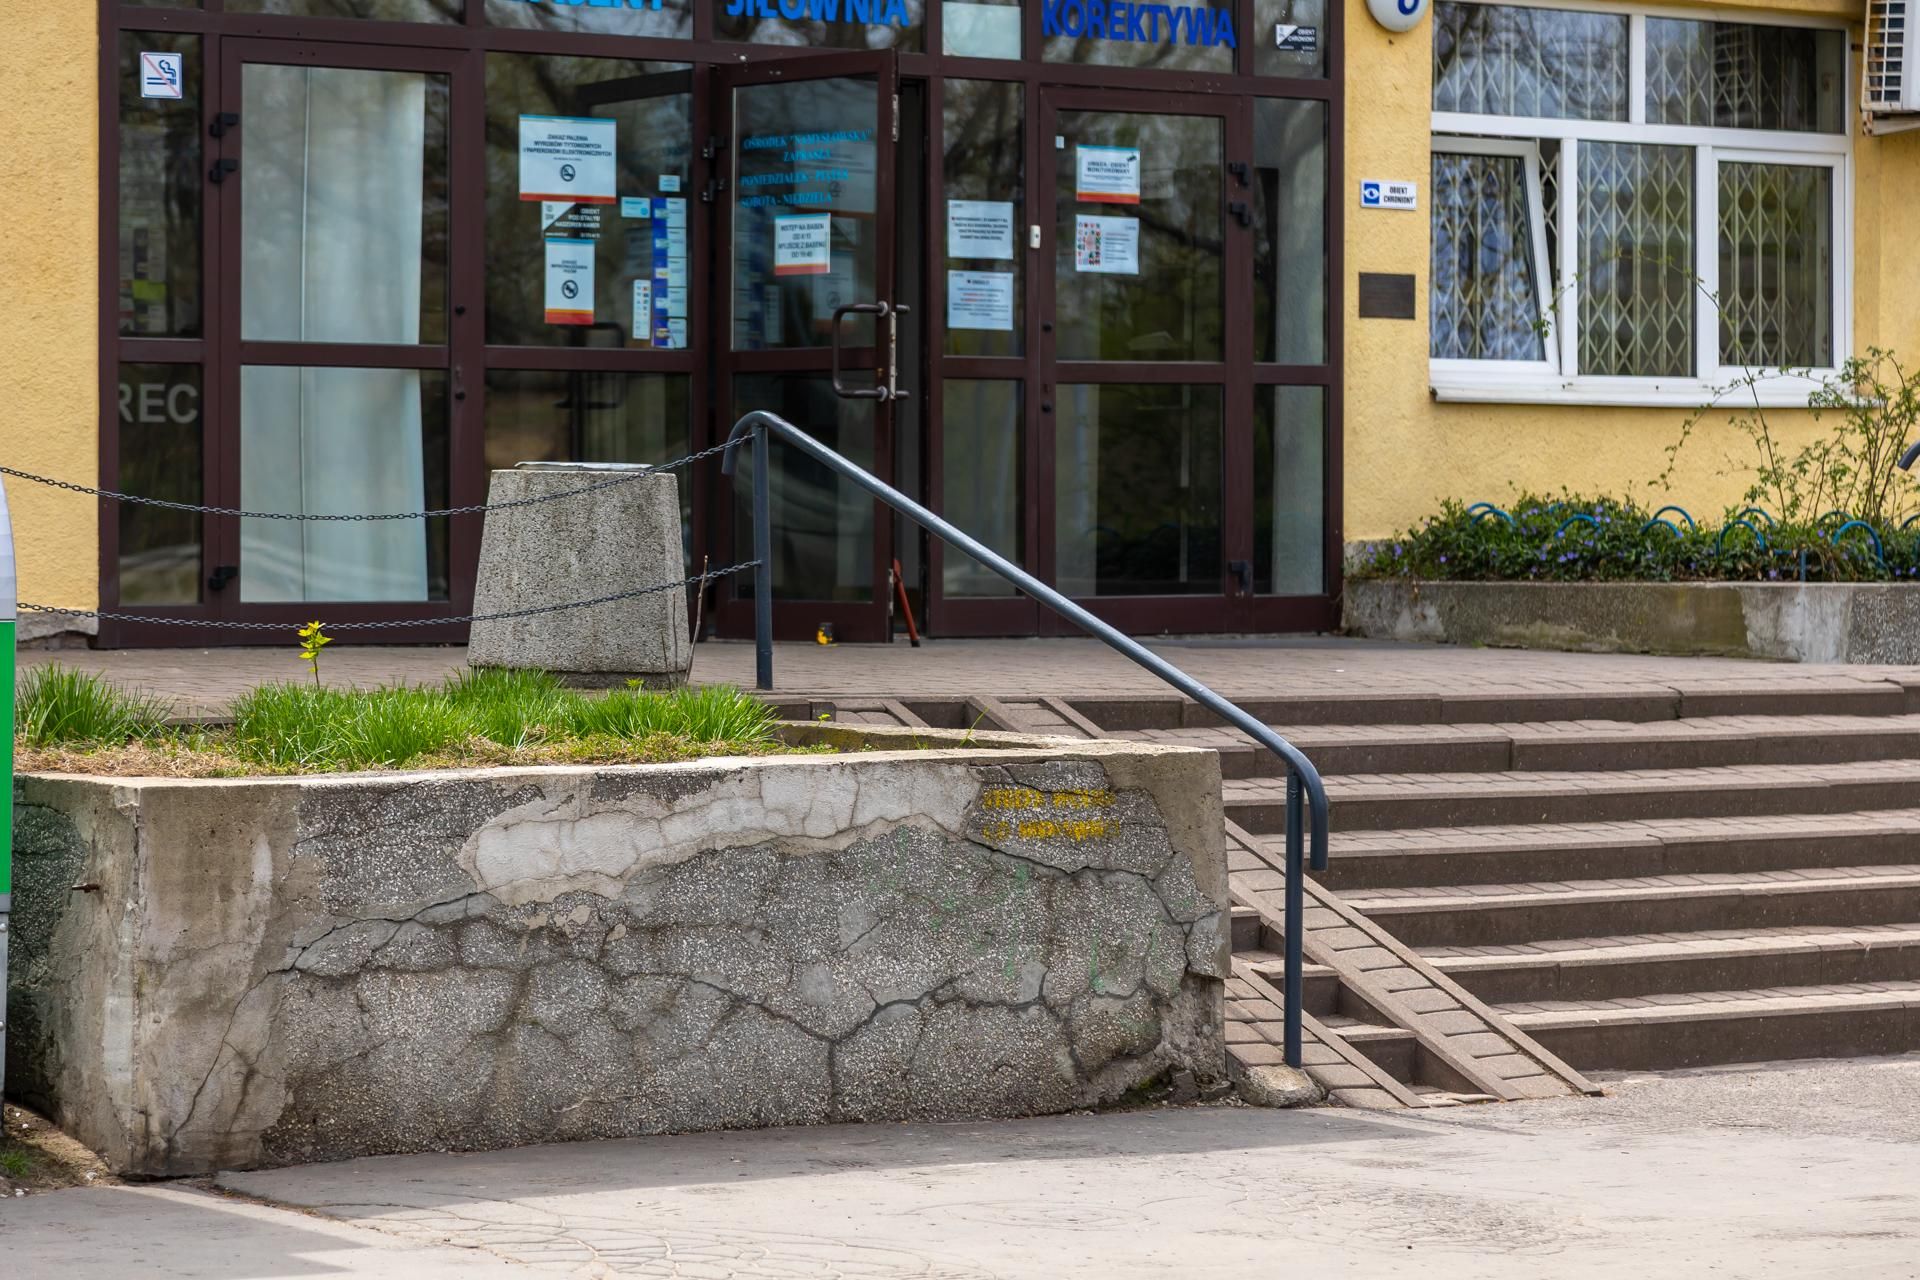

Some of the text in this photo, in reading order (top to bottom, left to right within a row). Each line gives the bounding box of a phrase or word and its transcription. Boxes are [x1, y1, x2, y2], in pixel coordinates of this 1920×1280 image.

[1043, 0, 1237, 48] KOREKTYWA
[1383, 195, 1414, 205] CHRONIONY
[1389, 186, 1407, 195] OBIEKT
[118, 383, 199, 424] REC
